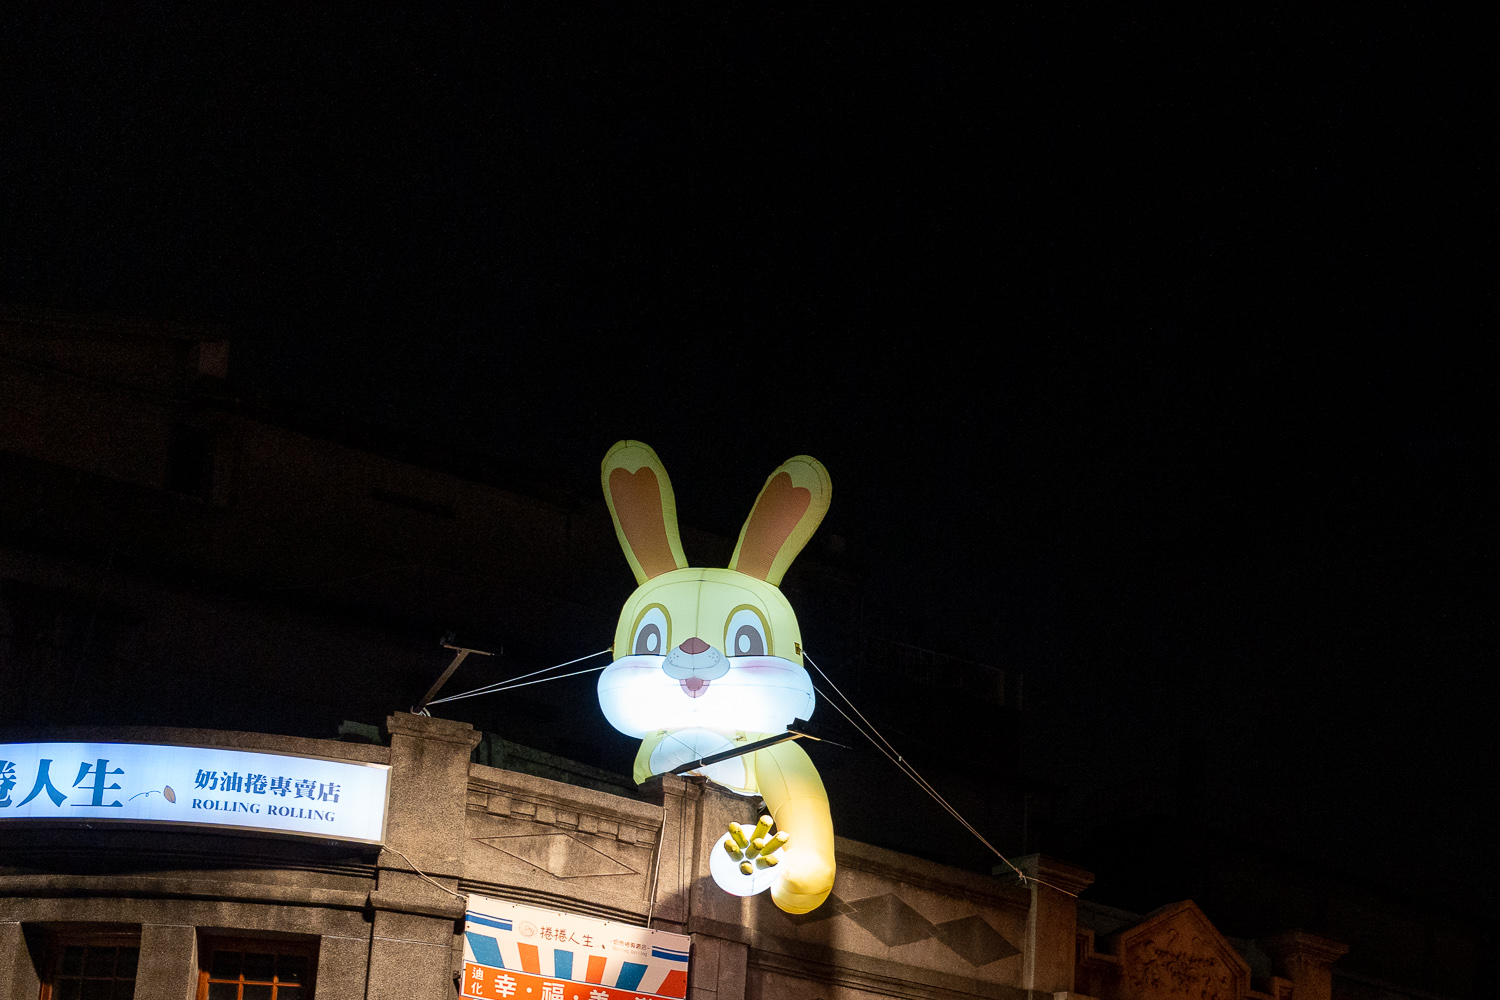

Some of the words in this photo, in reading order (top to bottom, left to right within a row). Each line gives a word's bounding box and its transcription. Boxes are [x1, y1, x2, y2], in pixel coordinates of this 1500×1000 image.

[194, 768, 342, 804] 奶油捲專賣店
[192, 798, 261, 815] ROLLING
[268, 803, 336, 822] ROLLING
[539, 925, 594, 948] 捲捲人生
[471, 966, 484, 996] 迪化
